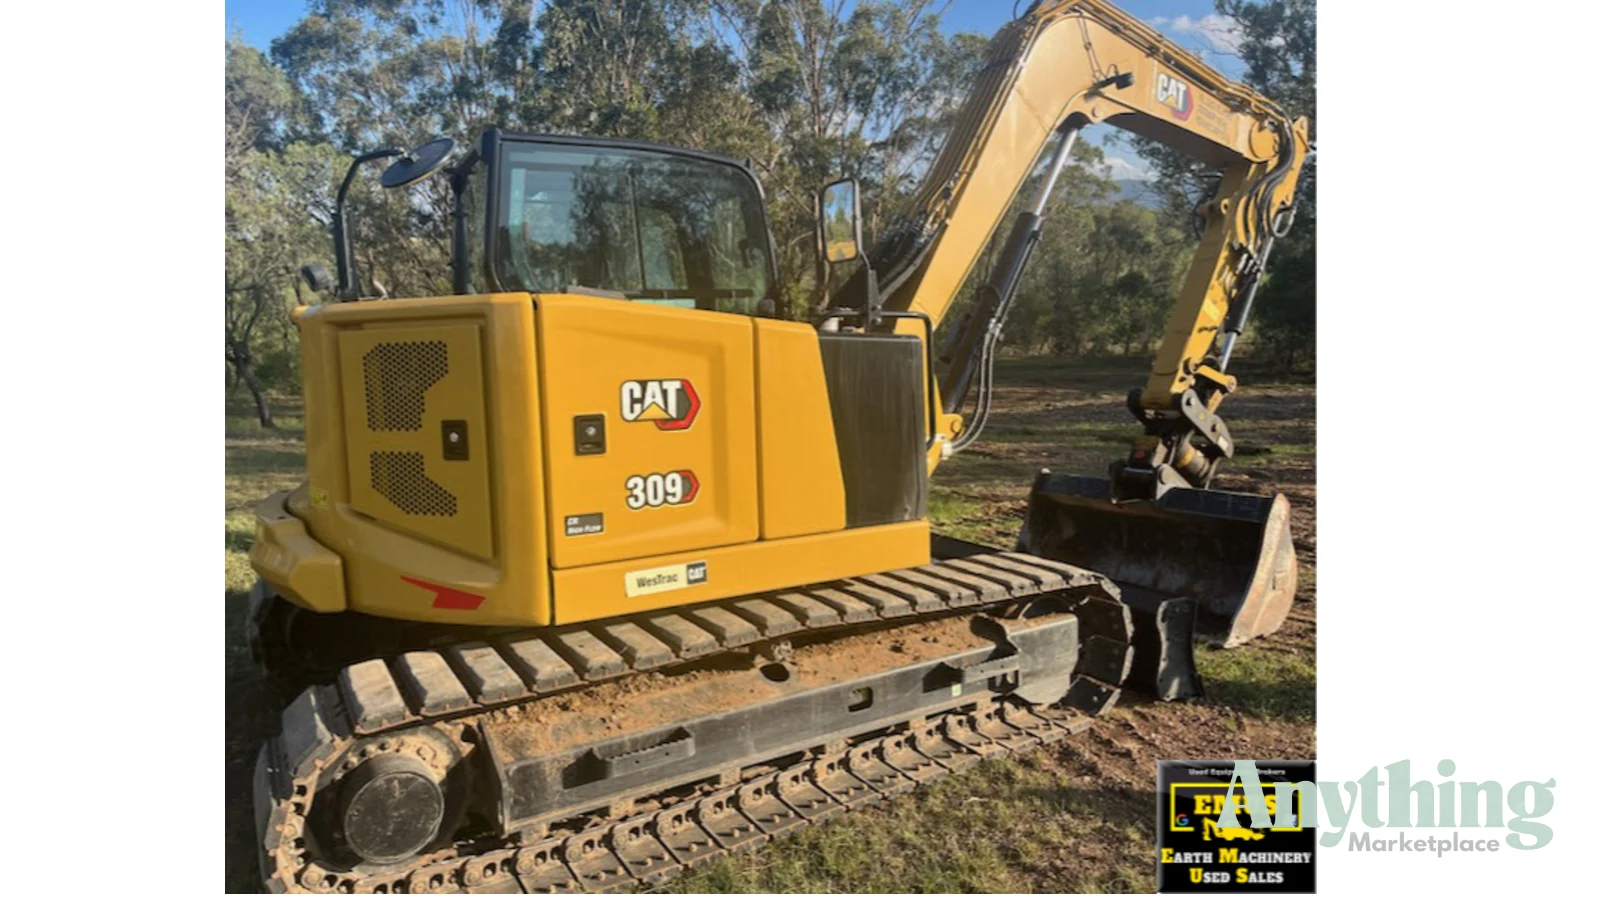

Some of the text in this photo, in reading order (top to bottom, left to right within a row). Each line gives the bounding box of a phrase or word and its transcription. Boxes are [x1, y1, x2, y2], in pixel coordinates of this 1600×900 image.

[1157, 73, 1188, 112] CAT
[620, 380, 682, 421] CAT
[626, 471, 682, 509] 309
[636, 566, 706, 588] WesTrac CAT
